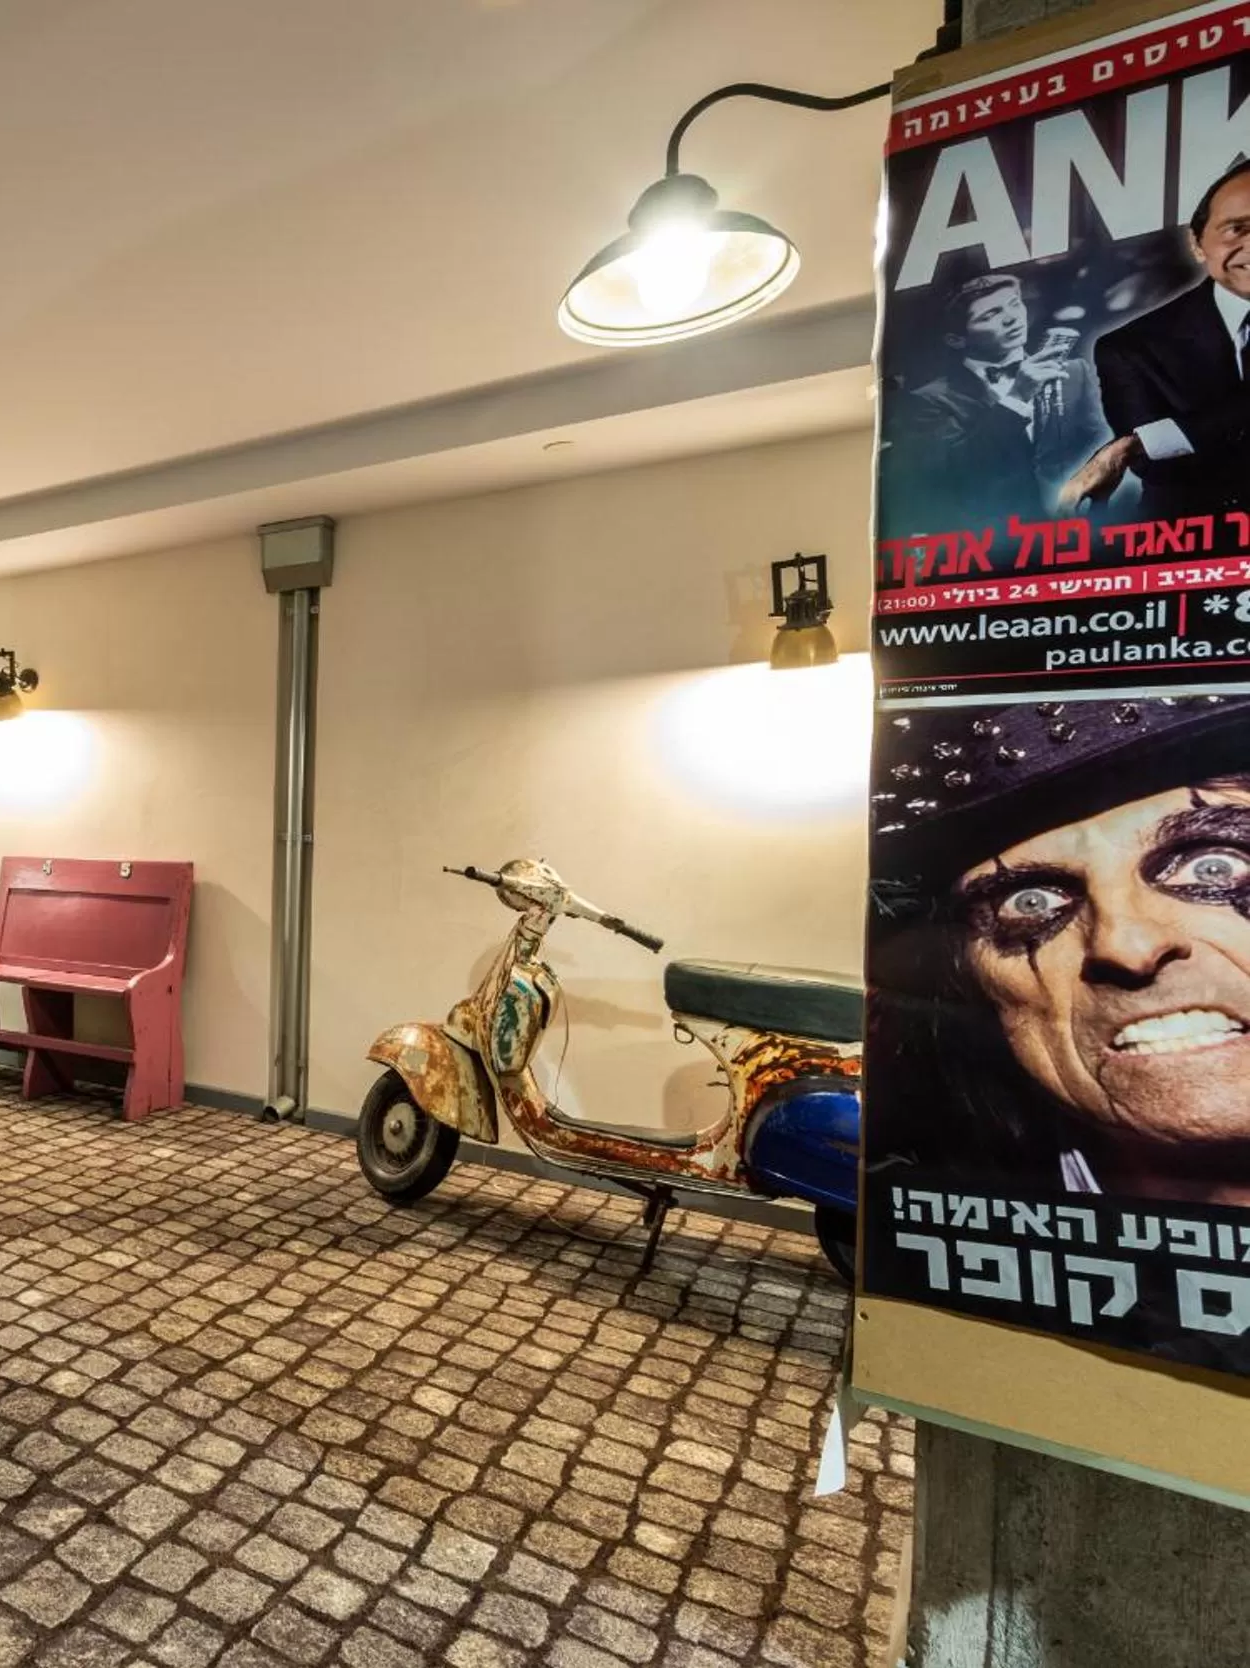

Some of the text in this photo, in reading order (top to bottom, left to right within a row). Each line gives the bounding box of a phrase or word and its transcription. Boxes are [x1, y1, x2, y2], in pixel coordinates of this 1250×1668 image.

[904, 74, 1067, 139] בעיצומה
[1007, 514, 1091, 569] פול
[1101, 515, 1214, 558] האגדי
[943, 586, 1000, 604] ביולי
[1009, 584, 1039, 600] 24
[1049, 575, 1132, 595] חמישי
[879, 600, 1166, 647] www.leaan.co.il
[1046, 636, 1250, 670] paulanka.c
[891, 1186, 1250, 1262] ופע האימה!
[895, 1231, 1138, 1326] קופר
